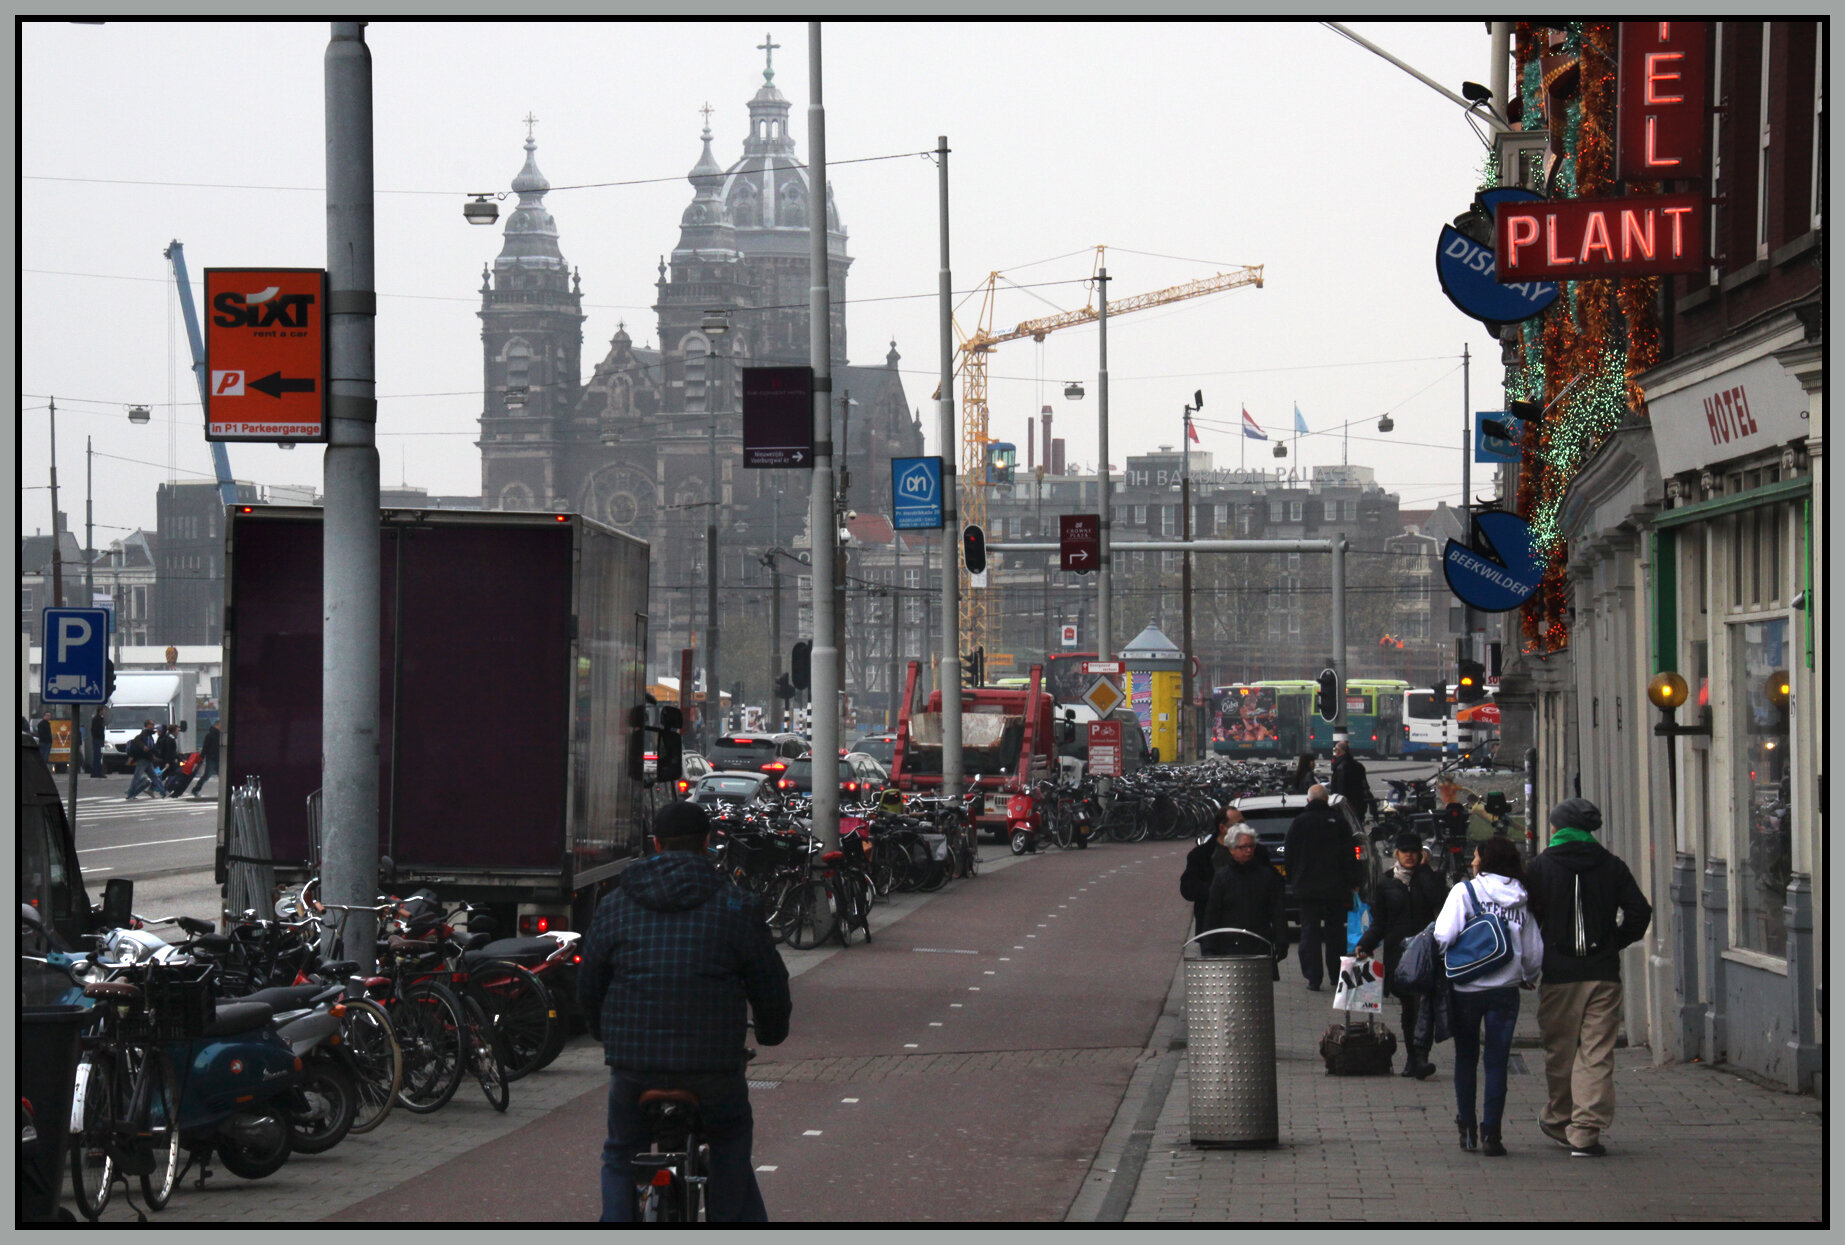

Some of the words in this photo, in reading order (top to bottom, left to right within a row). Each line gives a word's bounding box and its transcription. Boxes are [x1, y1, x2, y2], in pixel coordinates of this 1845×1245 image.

[1506, 206, 1693, 269] PLANT
[253, 330, 277, 338] rent
[211, 423, 222, 434] in
[225, 423, 238, 434] P1
[241, 423, 320, 436] Parkeergarage
[1703, 385, 1758, 446] HOTEL
[1276, 466, 1360, 483] PALACE
[1449, 549, 1531, 597] BEEKWILDER
[57, 616, 92, 663] P
[1091, 724, 1100, 736] P
